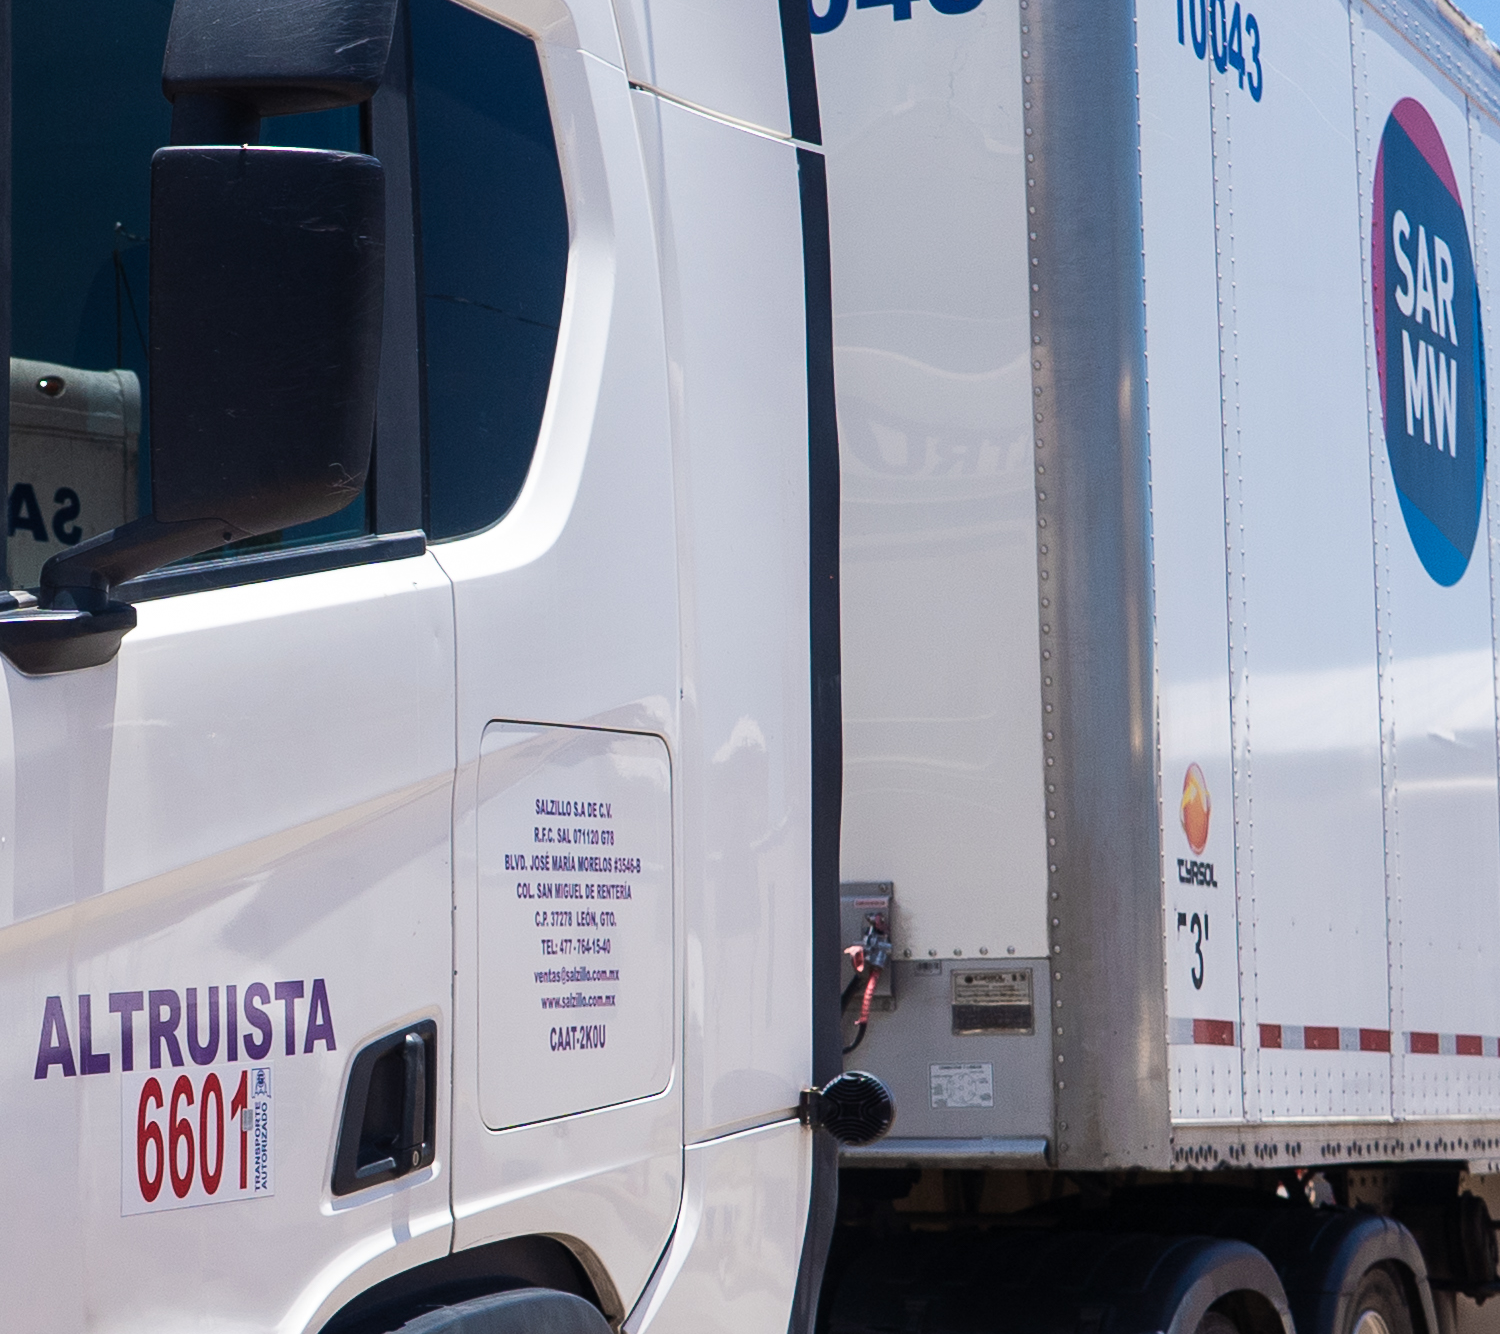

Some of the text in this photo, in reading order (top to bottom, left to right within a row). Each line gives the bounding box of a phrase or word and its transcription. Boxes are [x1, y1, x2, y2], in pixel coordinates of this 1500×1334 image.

[1392, 209, 1458, 348] SAR
[1402, 328, 1457, 459] MW
[535, 798, 572, 817] SALZILLO
[587, 802, 598, 818] DE
[599, 803, 613, 818] C.V.
[534, 827, 555, 843] R.F.C.
[557, 827, 572, 844] SAL
[573, 828, 599, 845] 071120
[504, 854, 528, 871] BLVD.
[529, 851, 550, 871] JOSÉ
[551, 852, 576, 872] MARÍA
[577, 855, 612, 873] MORELOS
[516, 880, 632, 900] COL. SAN MIGUEL DE RENTERÍA
[534, 911, 549, 927] C.P.
[576, 907, 598, 930] LEÓN,
[600, 911, 617, 927] GTO.
[541, 939, 558, 955] TEL:
[534, 966, 620, 985] ventas@salzillo.com.mx
[541, 992, 616, 1009] www.salzillo.com.mx
[34, 978, 337, 1080] ALTRUISTA
[137, 1069, 249, 1203] 6601
